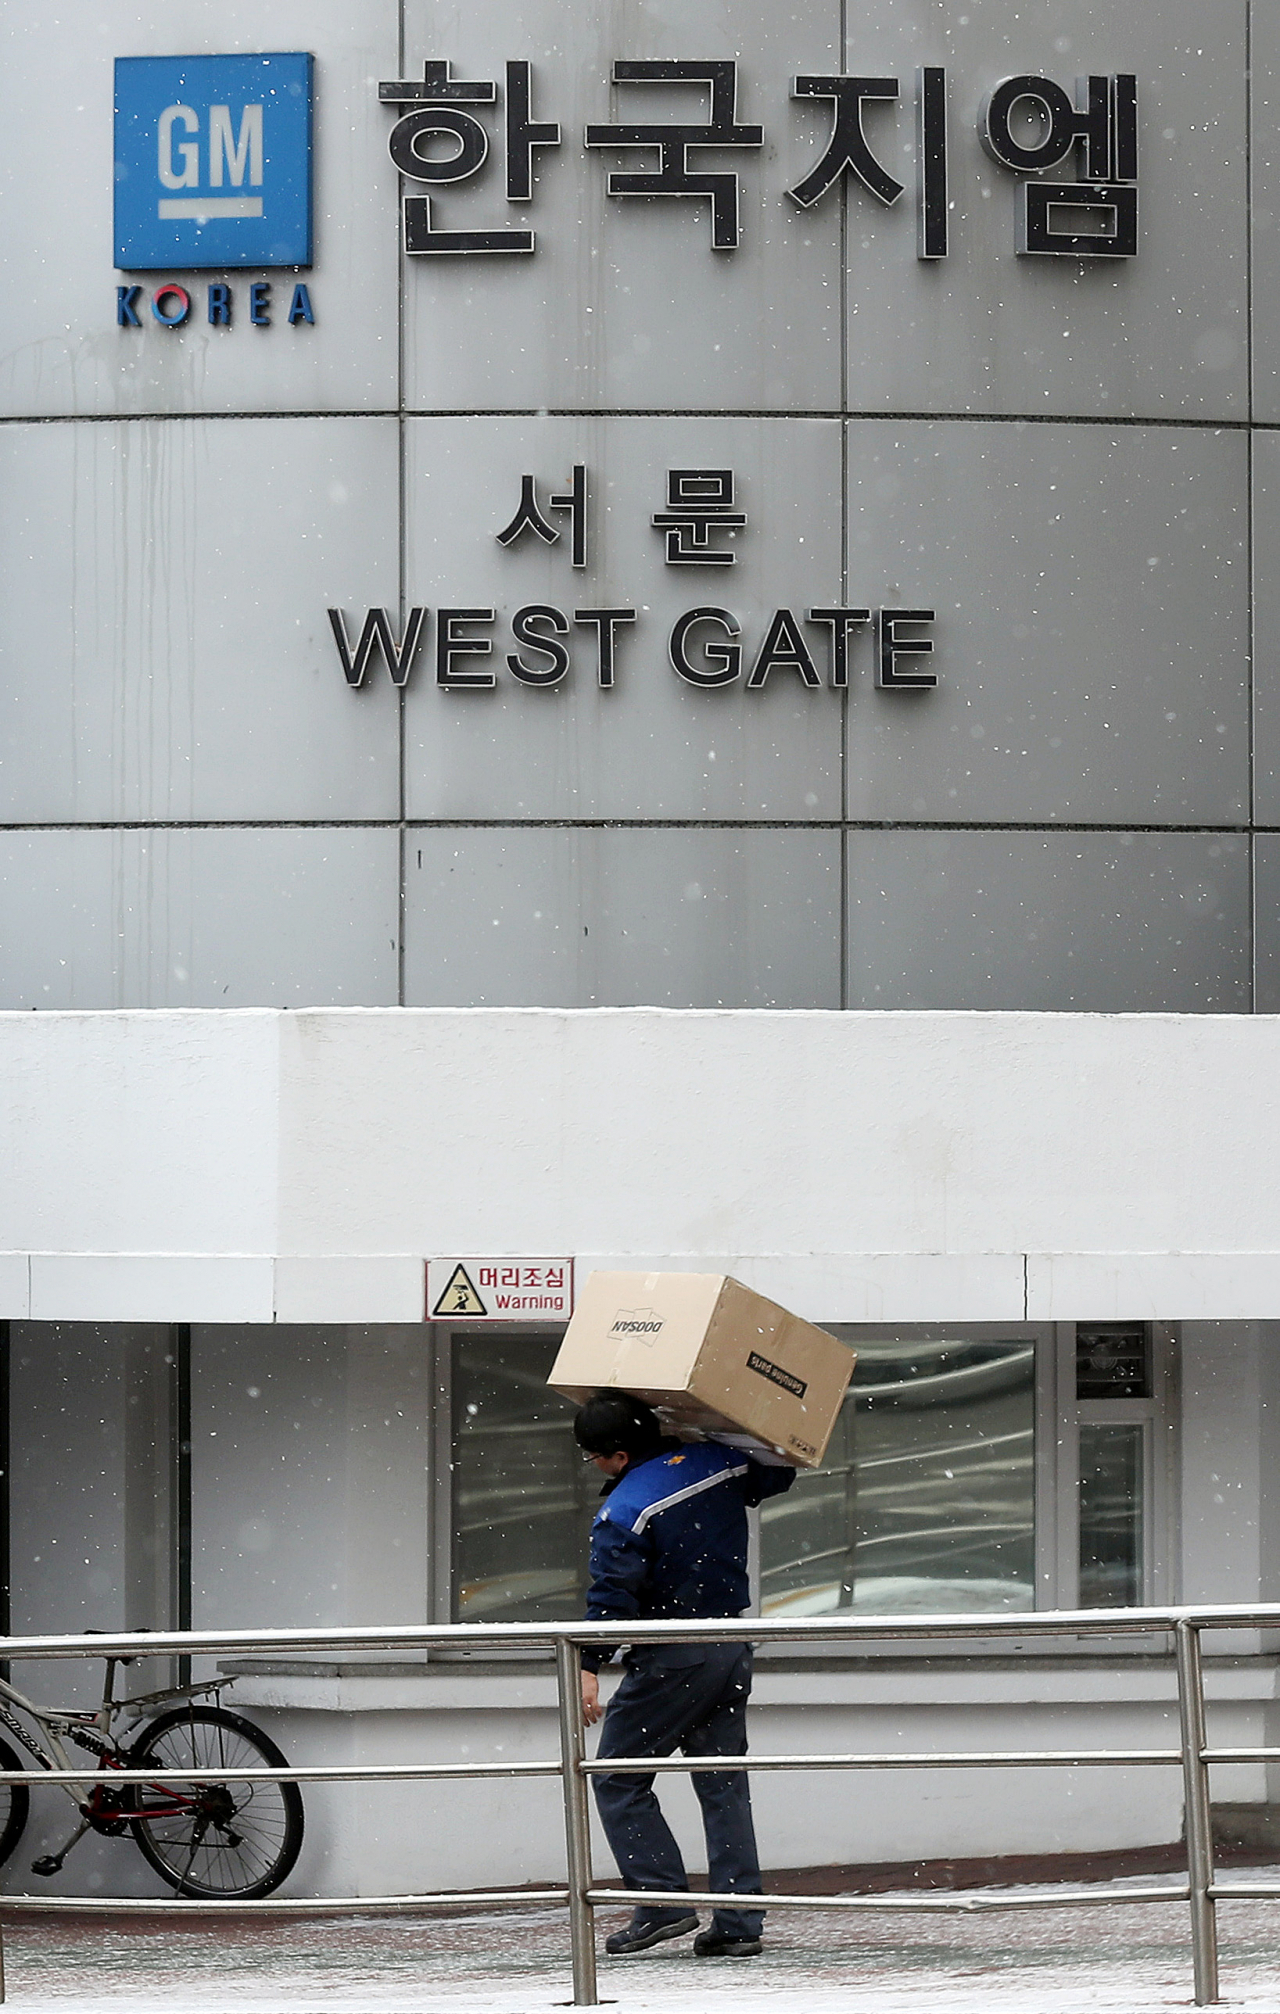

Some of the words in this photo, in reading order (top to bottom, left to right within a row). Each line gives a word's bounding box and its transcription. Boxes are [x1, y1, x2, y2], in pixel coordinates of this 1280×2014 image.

[157, 104, 264, 191] GM
[377, 59, 1138, 260] 한국지엠
[116, 282, 316, 327] KOREA
[326, 604, 638, 689] WEST
[669, 605, 938, 690] GATE
[479, 1267, 564, 1288] 머리조심
[495, 1294, 564, 1310] Warning
[611, 1320, 664, 1333] DOOSAN
